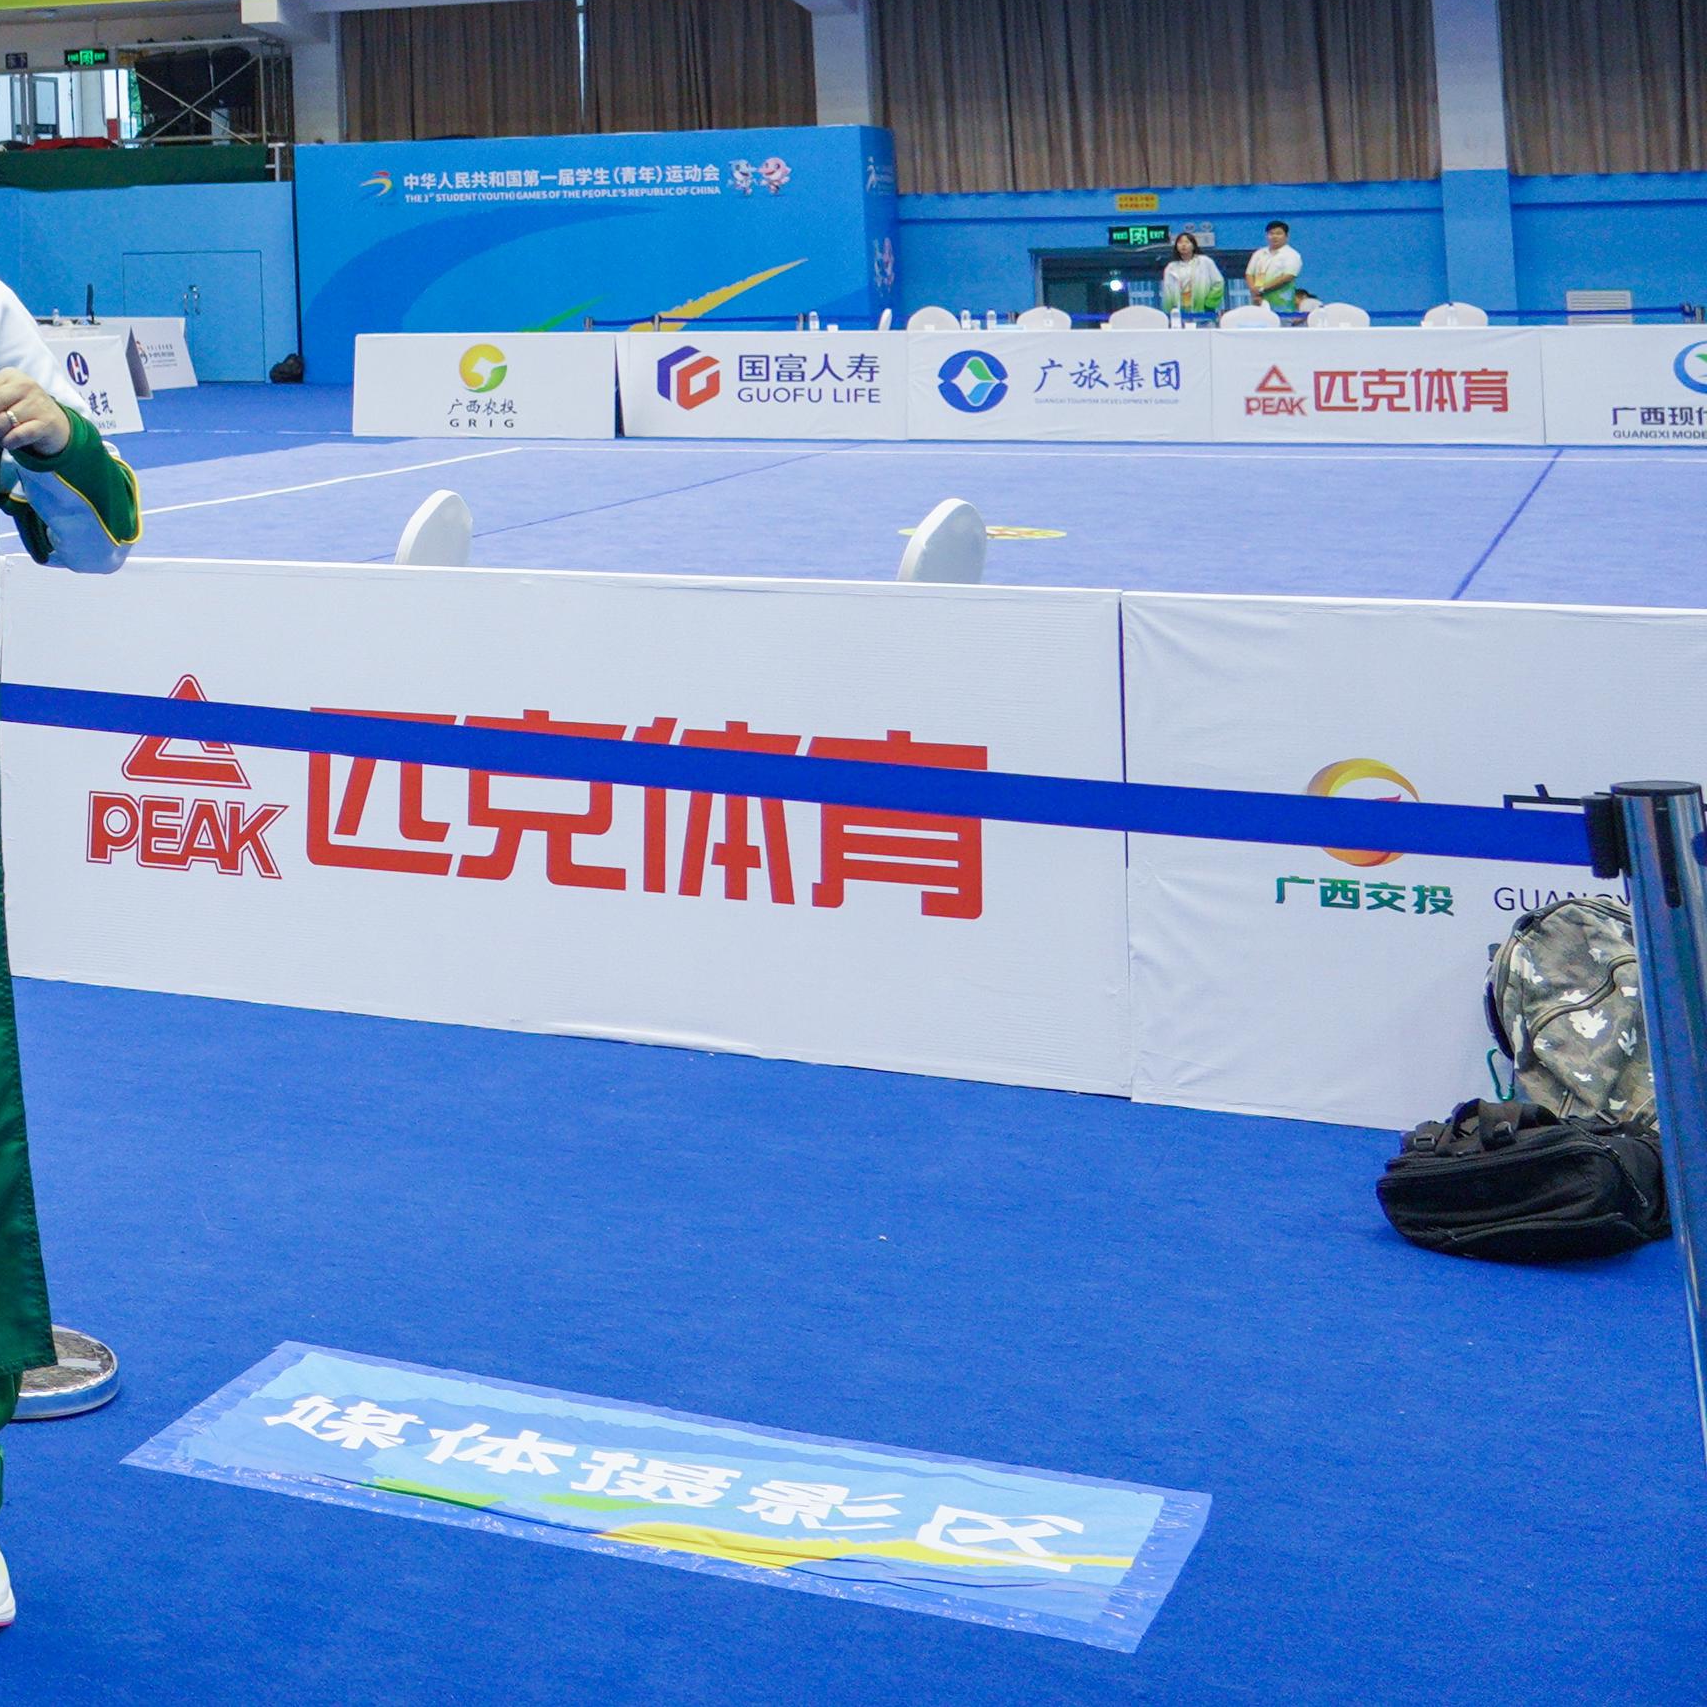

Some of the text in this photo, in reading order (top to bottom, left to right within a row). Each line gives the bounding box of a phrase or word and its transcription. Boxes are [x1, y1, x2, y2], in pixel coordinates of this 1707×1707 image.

[403, 164, 720, 191] 中华人民共和国第一届学生(青年)运动会
[405, 194, 423, 203] THE
[436, 192, 477, 202] STUDENT
[516, 190, 547, 200] GAMES
[549, 190, 561, 199] OF
[563, 189, 580, 199] THE
[582, 188, 627, 198] PEOPLE'S
[629, 187, 675, 197] REPUBLIC
[676, 186, 689, 196] OF
[690, 185, 721, 195] CHINA
[738, 353, 881, 384] 国富人寿
[1034, 358, 1181, 394] 广旅集团
[737, 387, 881, 404] GUOFU LIFE
[1313, 368, 1509, 415] 匹克体育
[447, 398, 518, 416] 广西农投
[1244, 396, 1309, 418] PEAK
[450, 419, 515, 429] GRIG
[1613, 430, 1670, 439] GUANGXI
[306, 709, 988, 920] 匹克体育
[86, 791, 289, 880] PEAK
[1274, 875, 1454, 917] 广西交投
[263, 1393, 1087, 1575] 媒体摄影区
